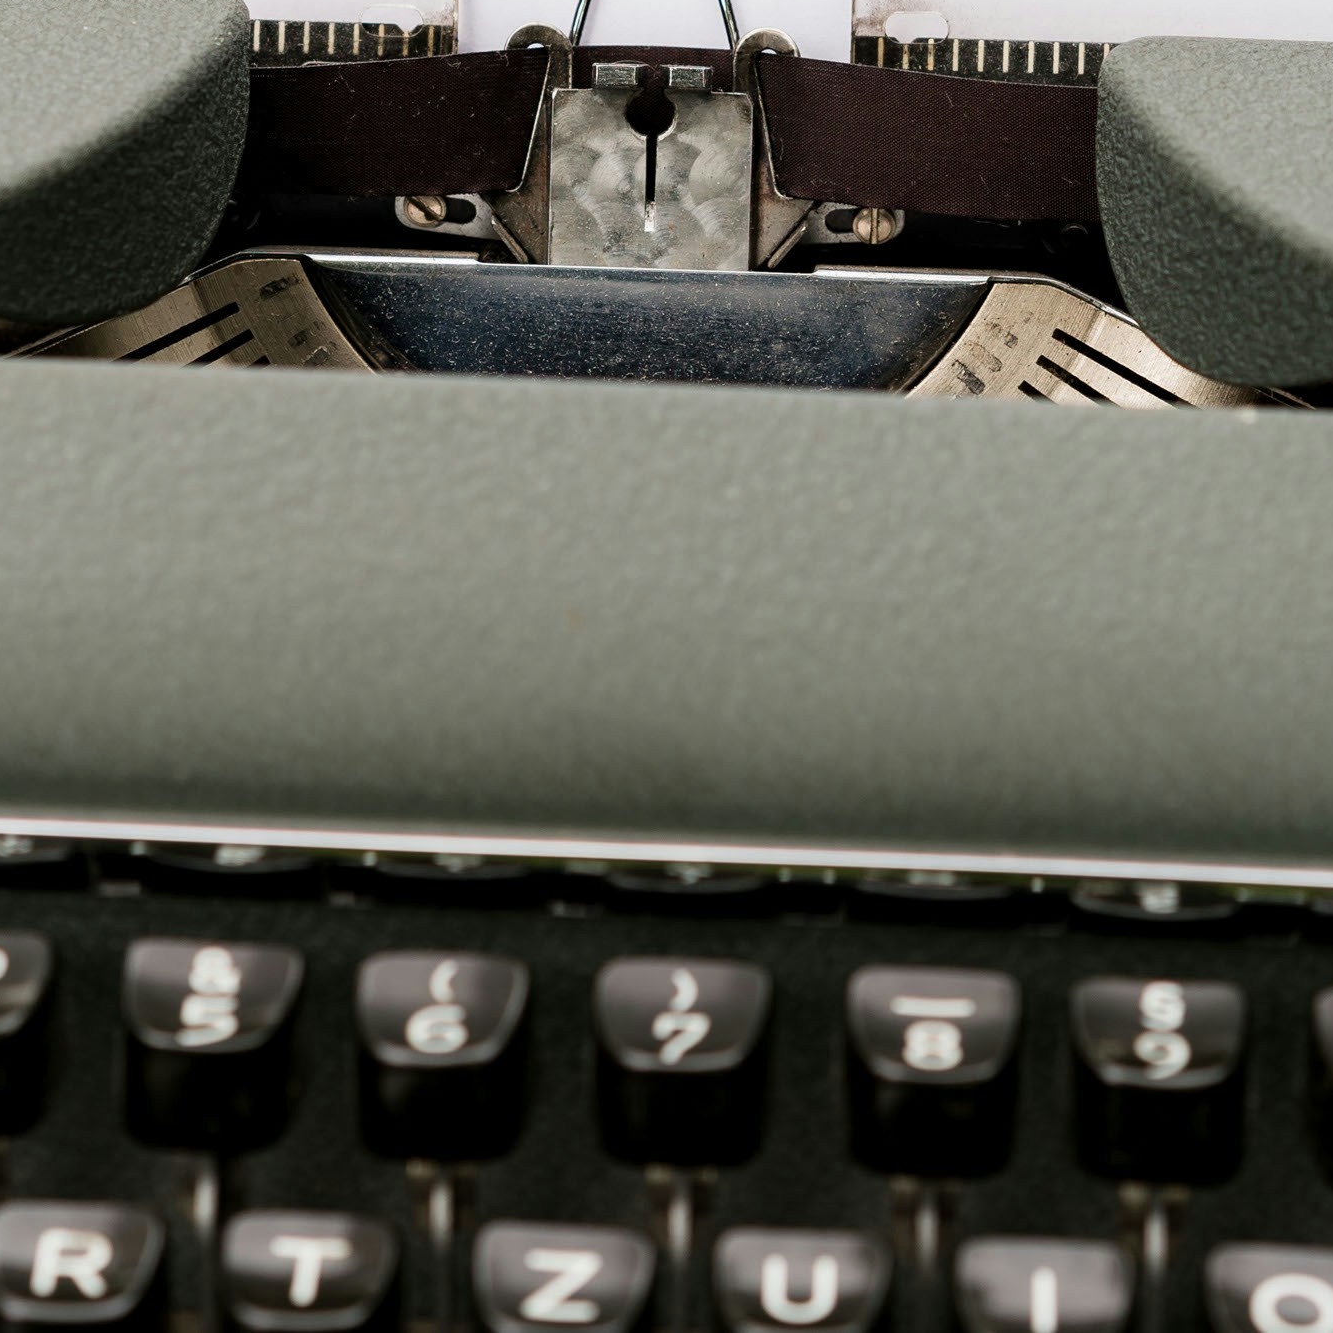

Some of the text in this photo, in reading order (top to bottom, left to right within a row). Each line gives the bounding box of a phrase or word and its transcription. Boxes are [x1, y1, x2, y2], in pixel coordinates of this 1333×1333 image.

[176, 995, 239, 1046] 5
[405, 1004, 467, 1054] 6
[651, 1012, 711, 1065] 7
[903, 1020, 964, 1071] 8
[1133, 1031, 1192, 1080] 9
[30, 1227, 114, 1299] R
[268, 1235, 353, 1307] T
[519, 1248, 604, 1323] Z
[761, 1253, 839, 1325] U
[1029, 1266, 1059, 1333] I
